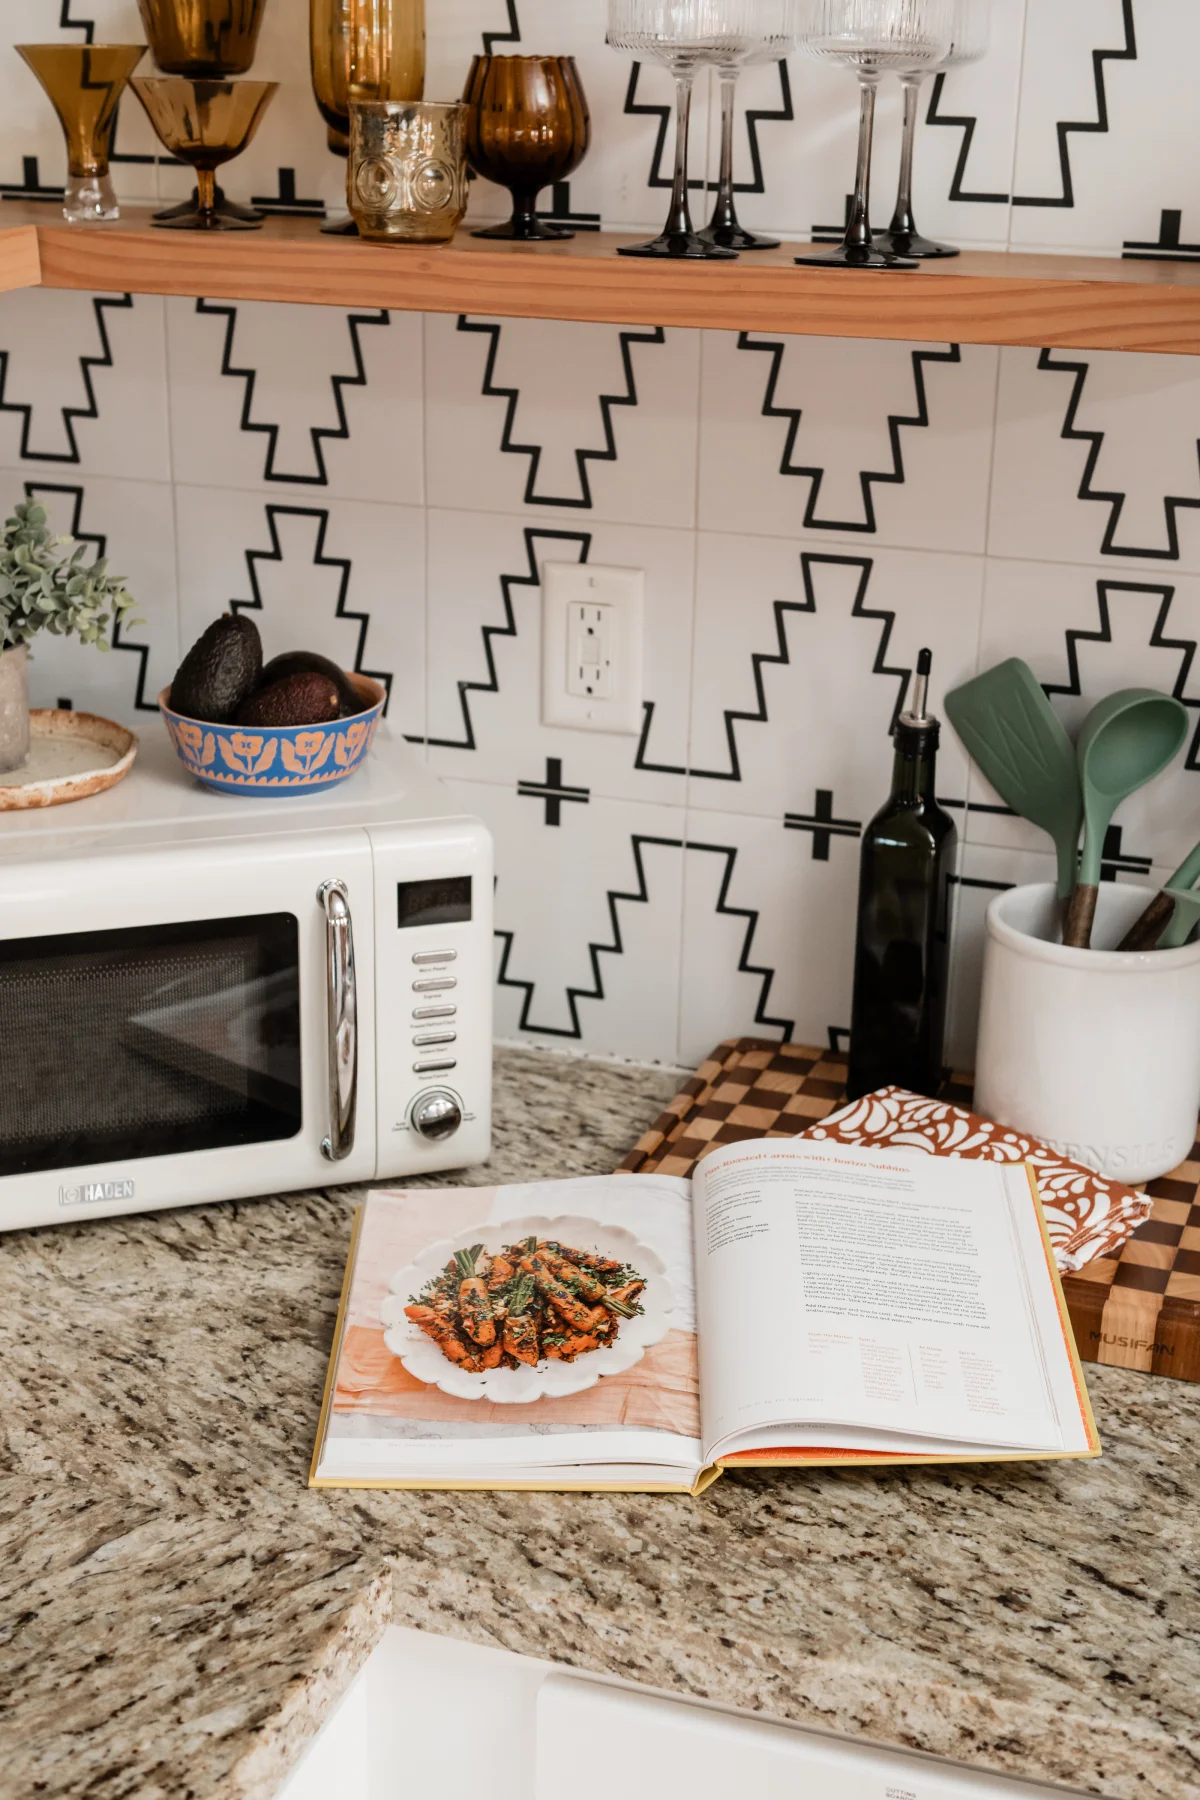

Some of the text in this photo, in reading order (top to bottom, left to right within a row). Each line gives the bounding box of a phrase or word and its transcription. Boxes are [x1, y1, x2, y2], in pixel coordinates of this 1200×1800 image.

[803, 1153, 826, 1162] with
[84, 1180, 133, 1202] HADEN
[1089, 1331, 1176, 1357] MUSIFAN
[886, 1786, 917, 1798] CUTTING
